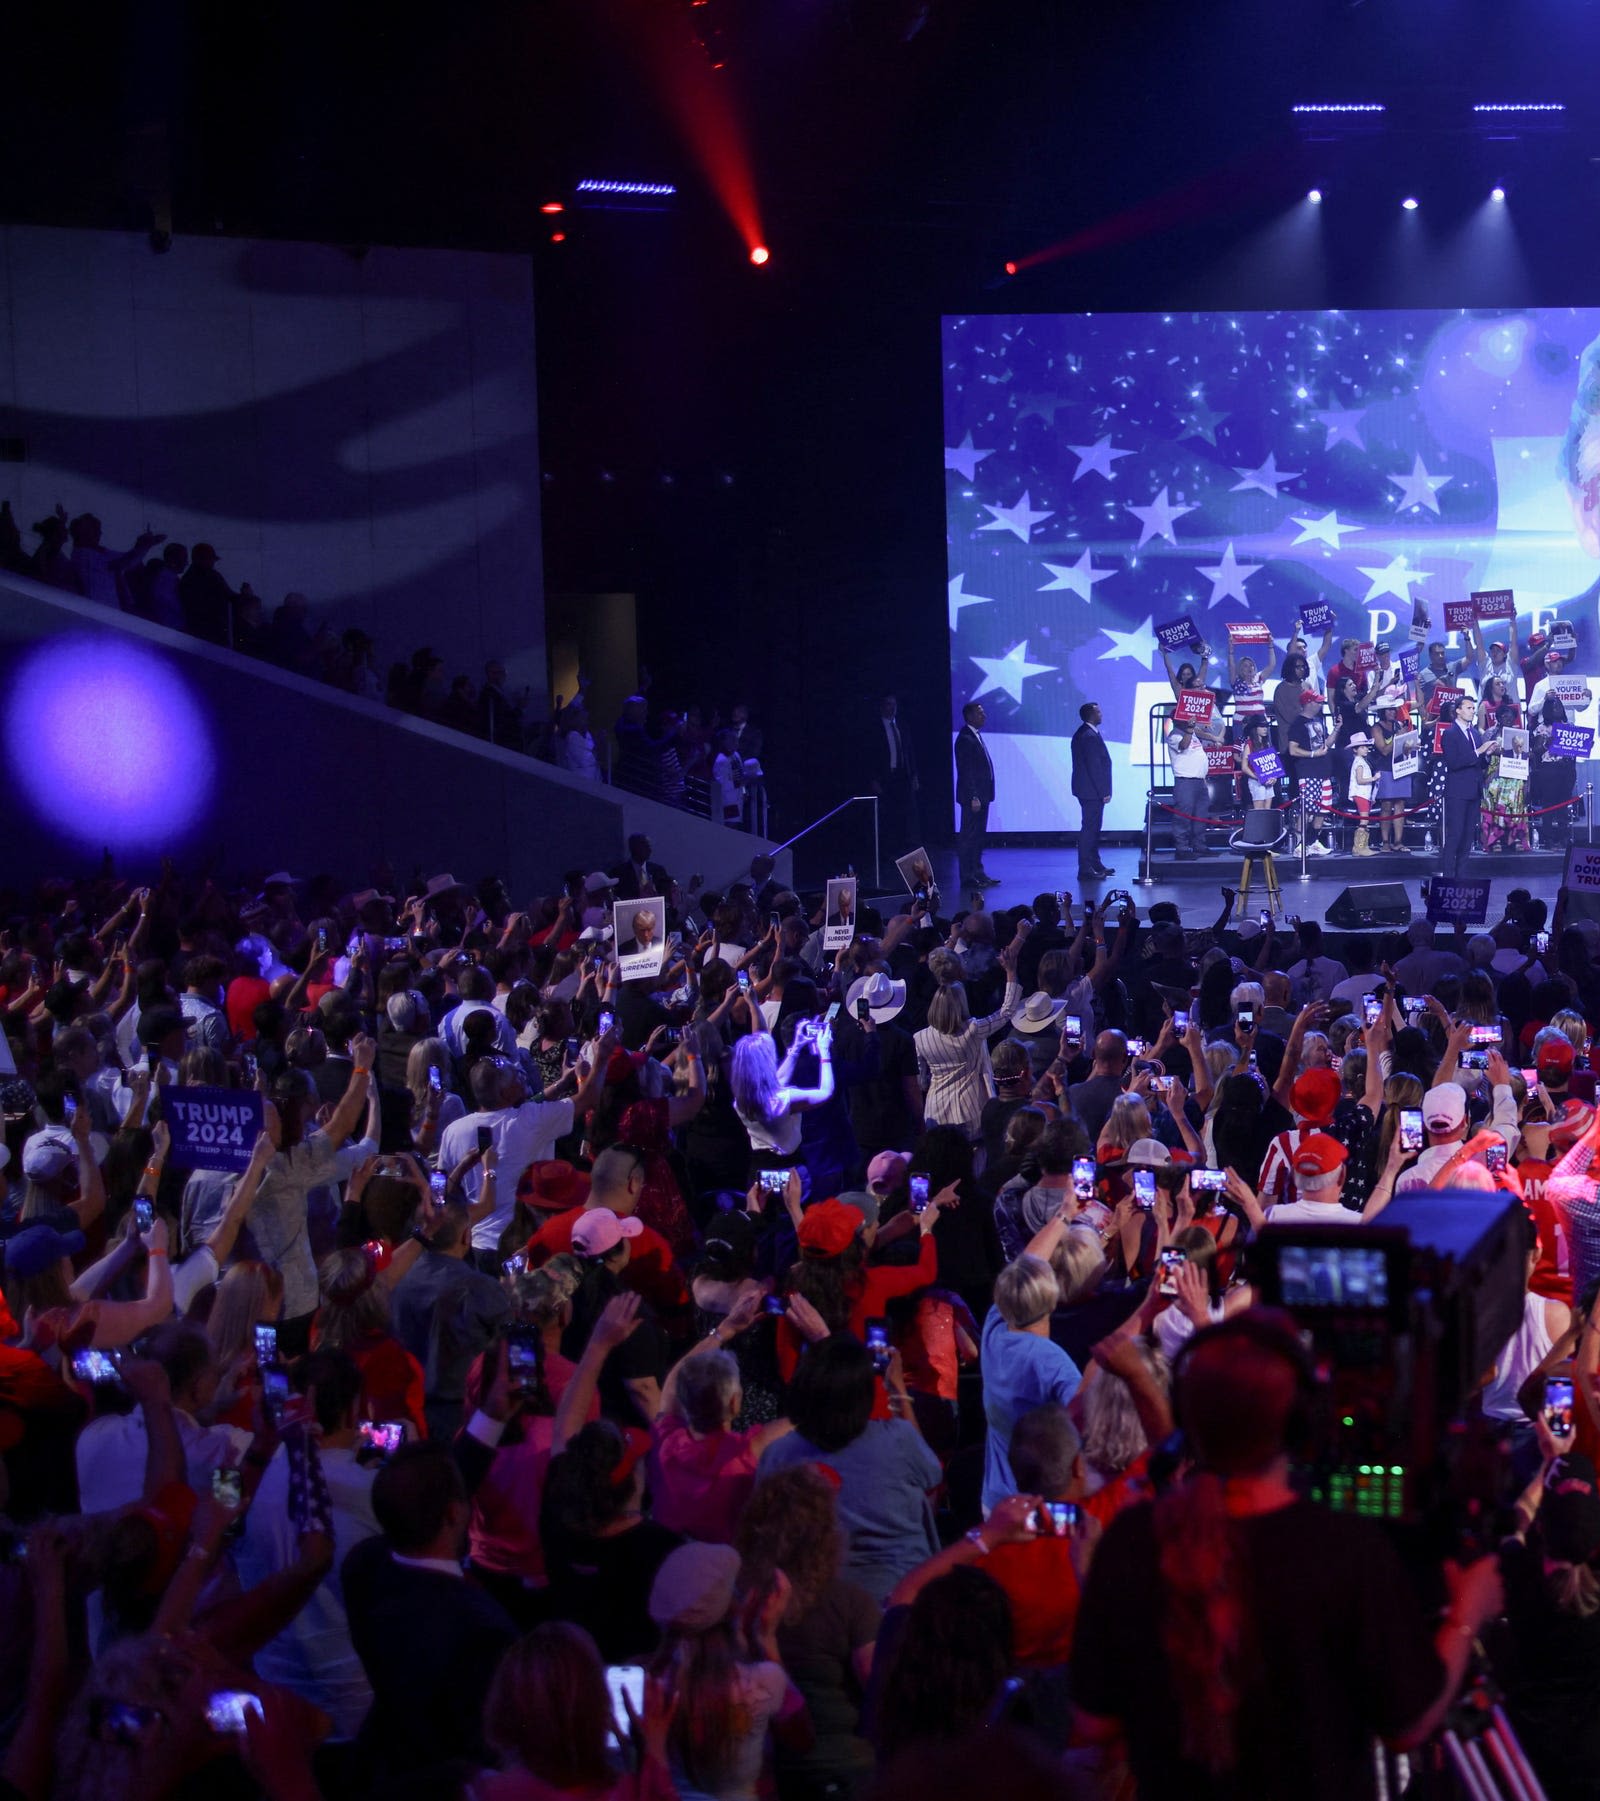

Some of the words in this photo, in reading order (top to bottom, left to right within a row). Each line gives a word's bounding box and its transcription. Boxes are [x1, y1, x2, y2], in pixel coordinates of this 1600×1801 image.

[1475, 595, 1510, 605] TRUMP
[1303, 605, 1329, 618] TRUMP
[1448, 607, 1473, 616] TRUM
[1480, 603, 1506, 612] 2024
[1308, 613, 1327, 625] 2024
[1159, 621, 1191, 639] TRUMP
[1166, 631, 1190, 644] 2024
[1182, 695, 1211, 706] TRUMP
[1184, 704, 1206, 714] 2024
[1556, 729, 1590, 740] TRUMP
[1559, 738, 1584, 747] 2024
[1207, 751, 1233, 759] RUMP
[1253, 753, 1277, 766] TRUMP
[1260, 762, 1278, 772] 2024
[1437, 887, 1484, 898] TRUMP
[1441, 898, 1476, 910] 2024
[172, 1102, 254, 1125] TRUMP
[187, 1122, 244, 1145] 2024
[195, 1145, 220, 1154] TRUMP
[222, 1146, 232, 1155] TO
